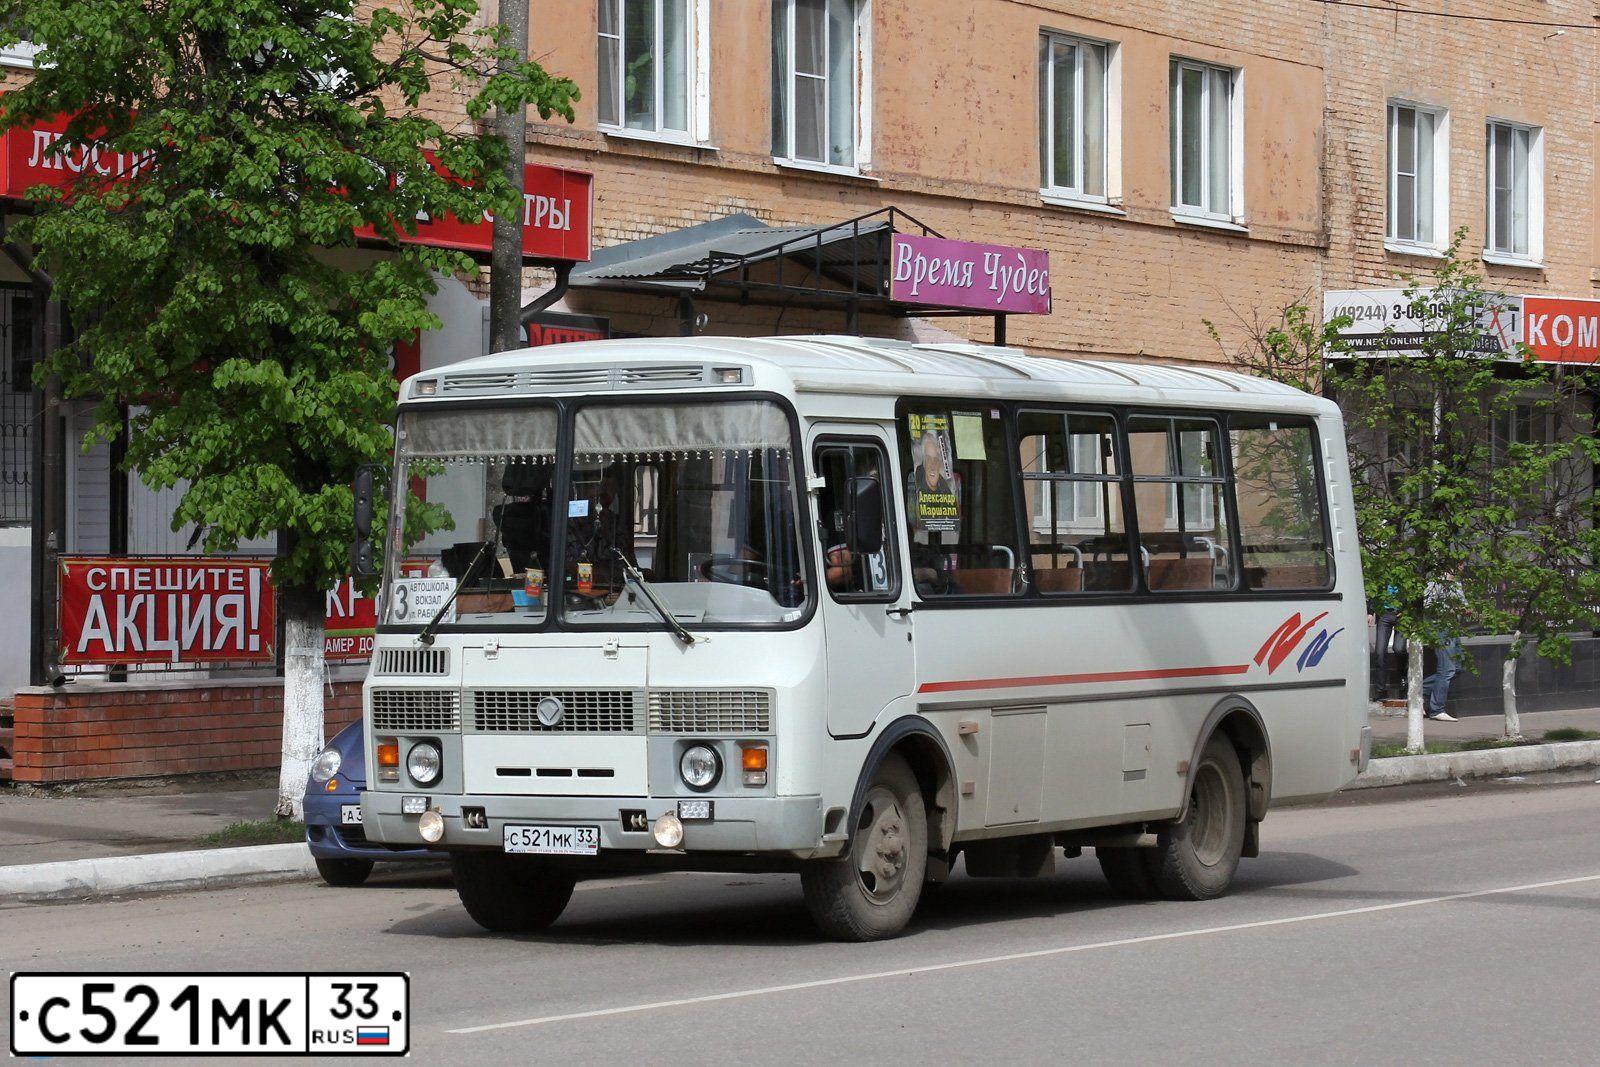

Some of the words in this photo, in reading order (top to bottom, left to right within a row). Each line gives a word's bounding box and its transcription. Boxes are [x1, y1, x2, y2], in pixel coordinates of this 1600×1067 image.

[28, 130, 157, 179] ЛЮСТР
[894, 242, 974, 296] Время
[983, 252, 1048, 304] Чудес
[1529, 313, 1598, 348] КОМ
[919, 491, 955, 505] Александр
[920, 504, 957, 518] Маршалл
[873, 550, 886, 585] 3
[86, 568, 244, 591] СПЕШИТЕ
[409, 582, 449, 592] АВТОШКОЛА
[395, 584, 408, 620] 3
[415, 595, 442, 605] ВОКЗАЛ
[76, 568, 261, 663] АКЦИЯ!
[417, 608, 450, 619] РАБОЯ
[325, 637, 355, 653] АМЕР
[358, 637, 374, 654] ДО
[510, 829, 572, 848] С521МК
[577, 829, 593, 843] 33
